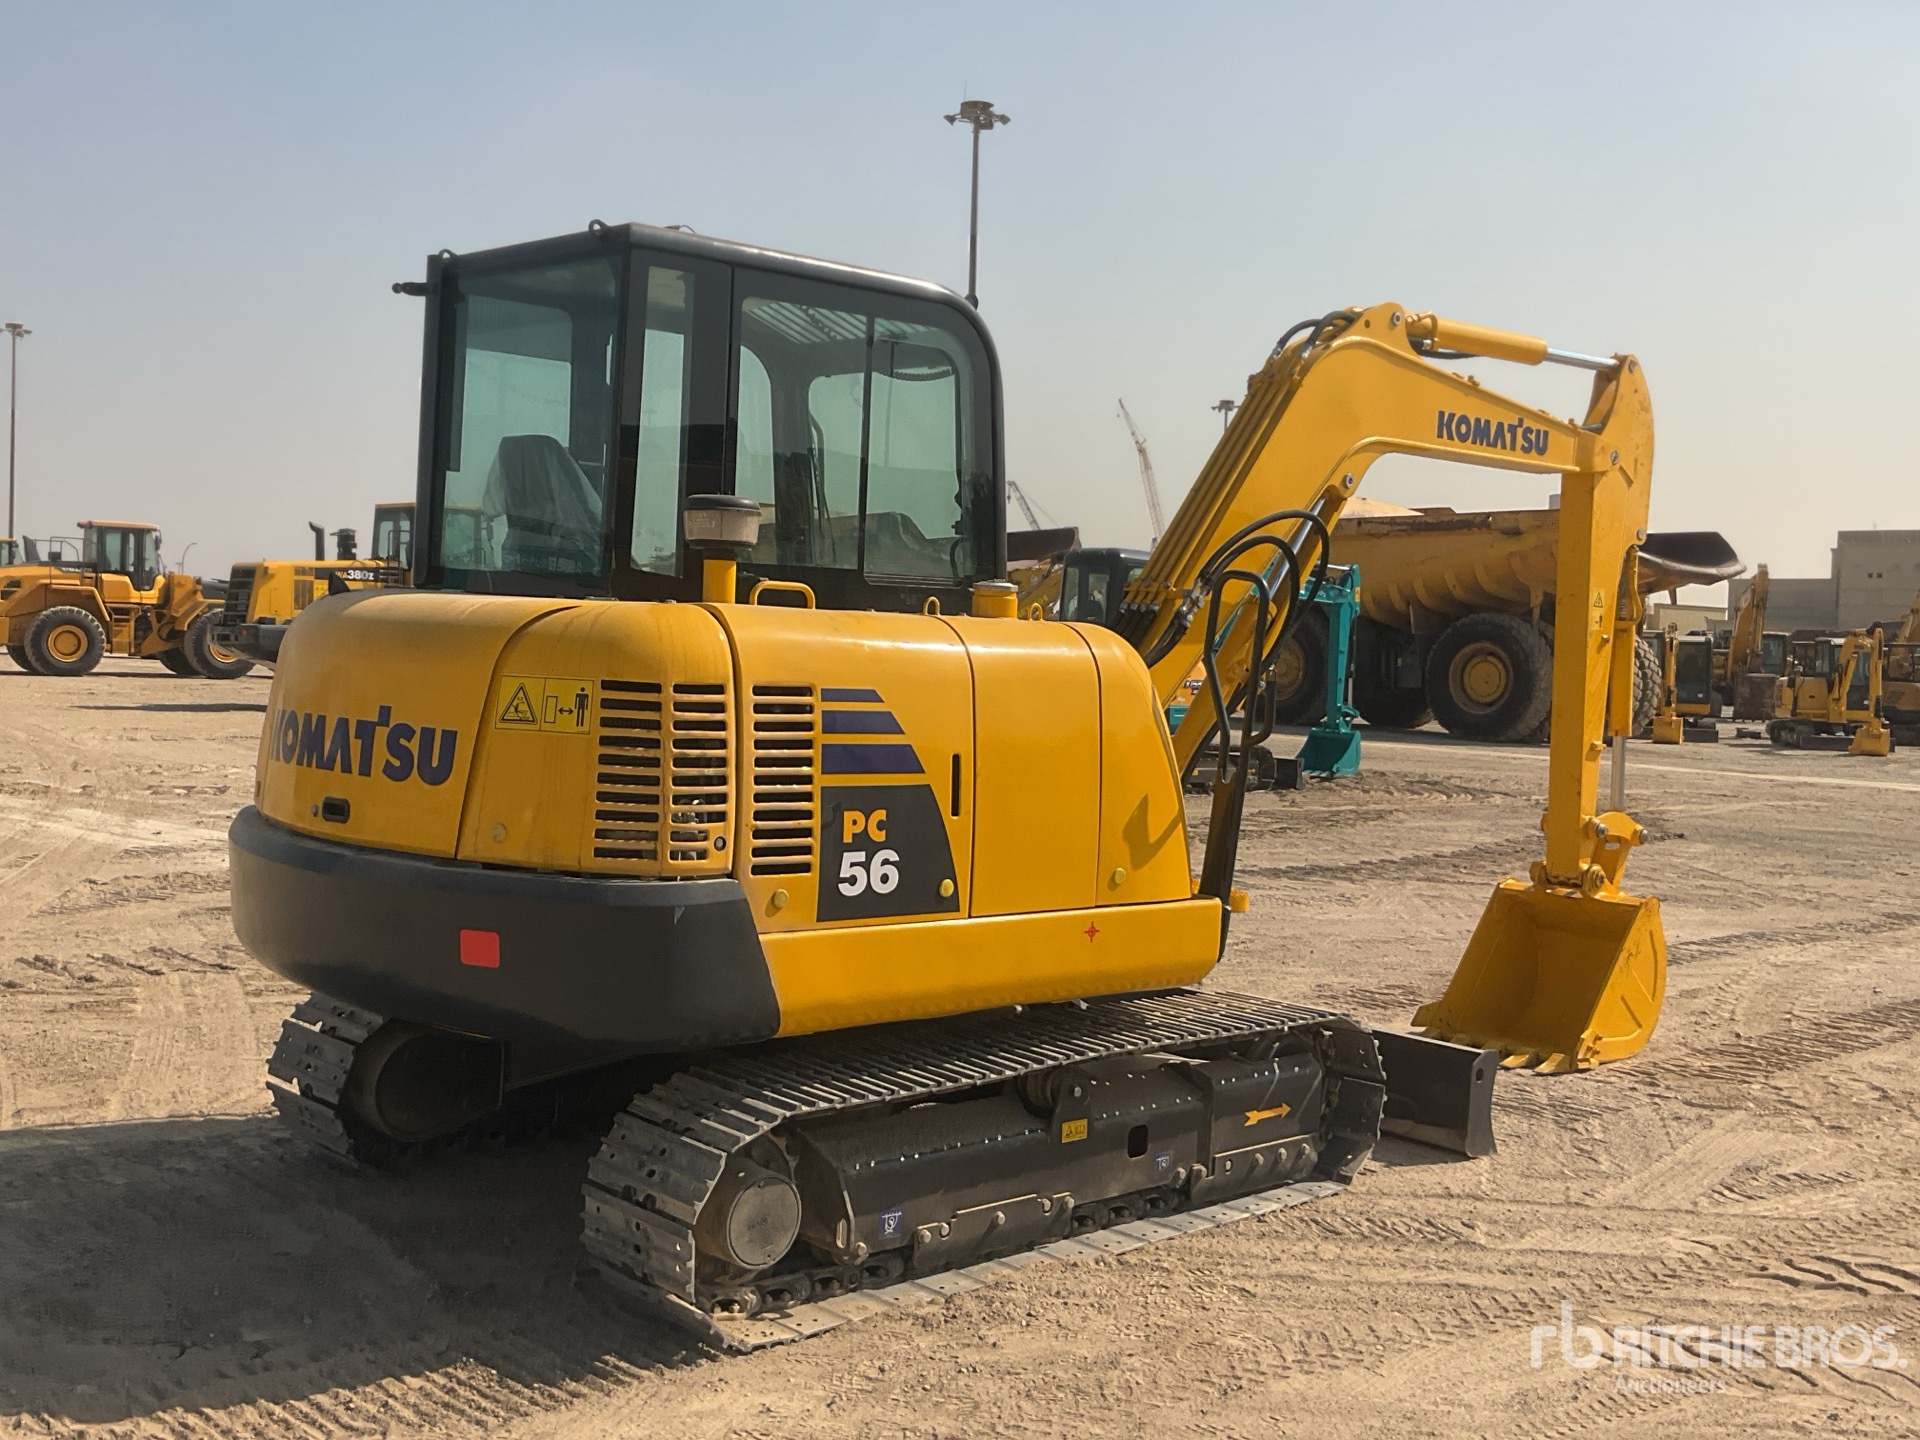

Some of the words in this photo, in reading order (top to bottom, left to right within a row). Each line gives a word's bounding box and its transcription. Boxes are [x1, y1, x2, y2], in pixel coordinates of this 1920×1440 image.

[1437, 410, 1549, 456] KOMATSU
[270, 705, 458, 786] KOMATSU
[843, 809, 887, 844] PC
[838, 849, 899, 897] 56
